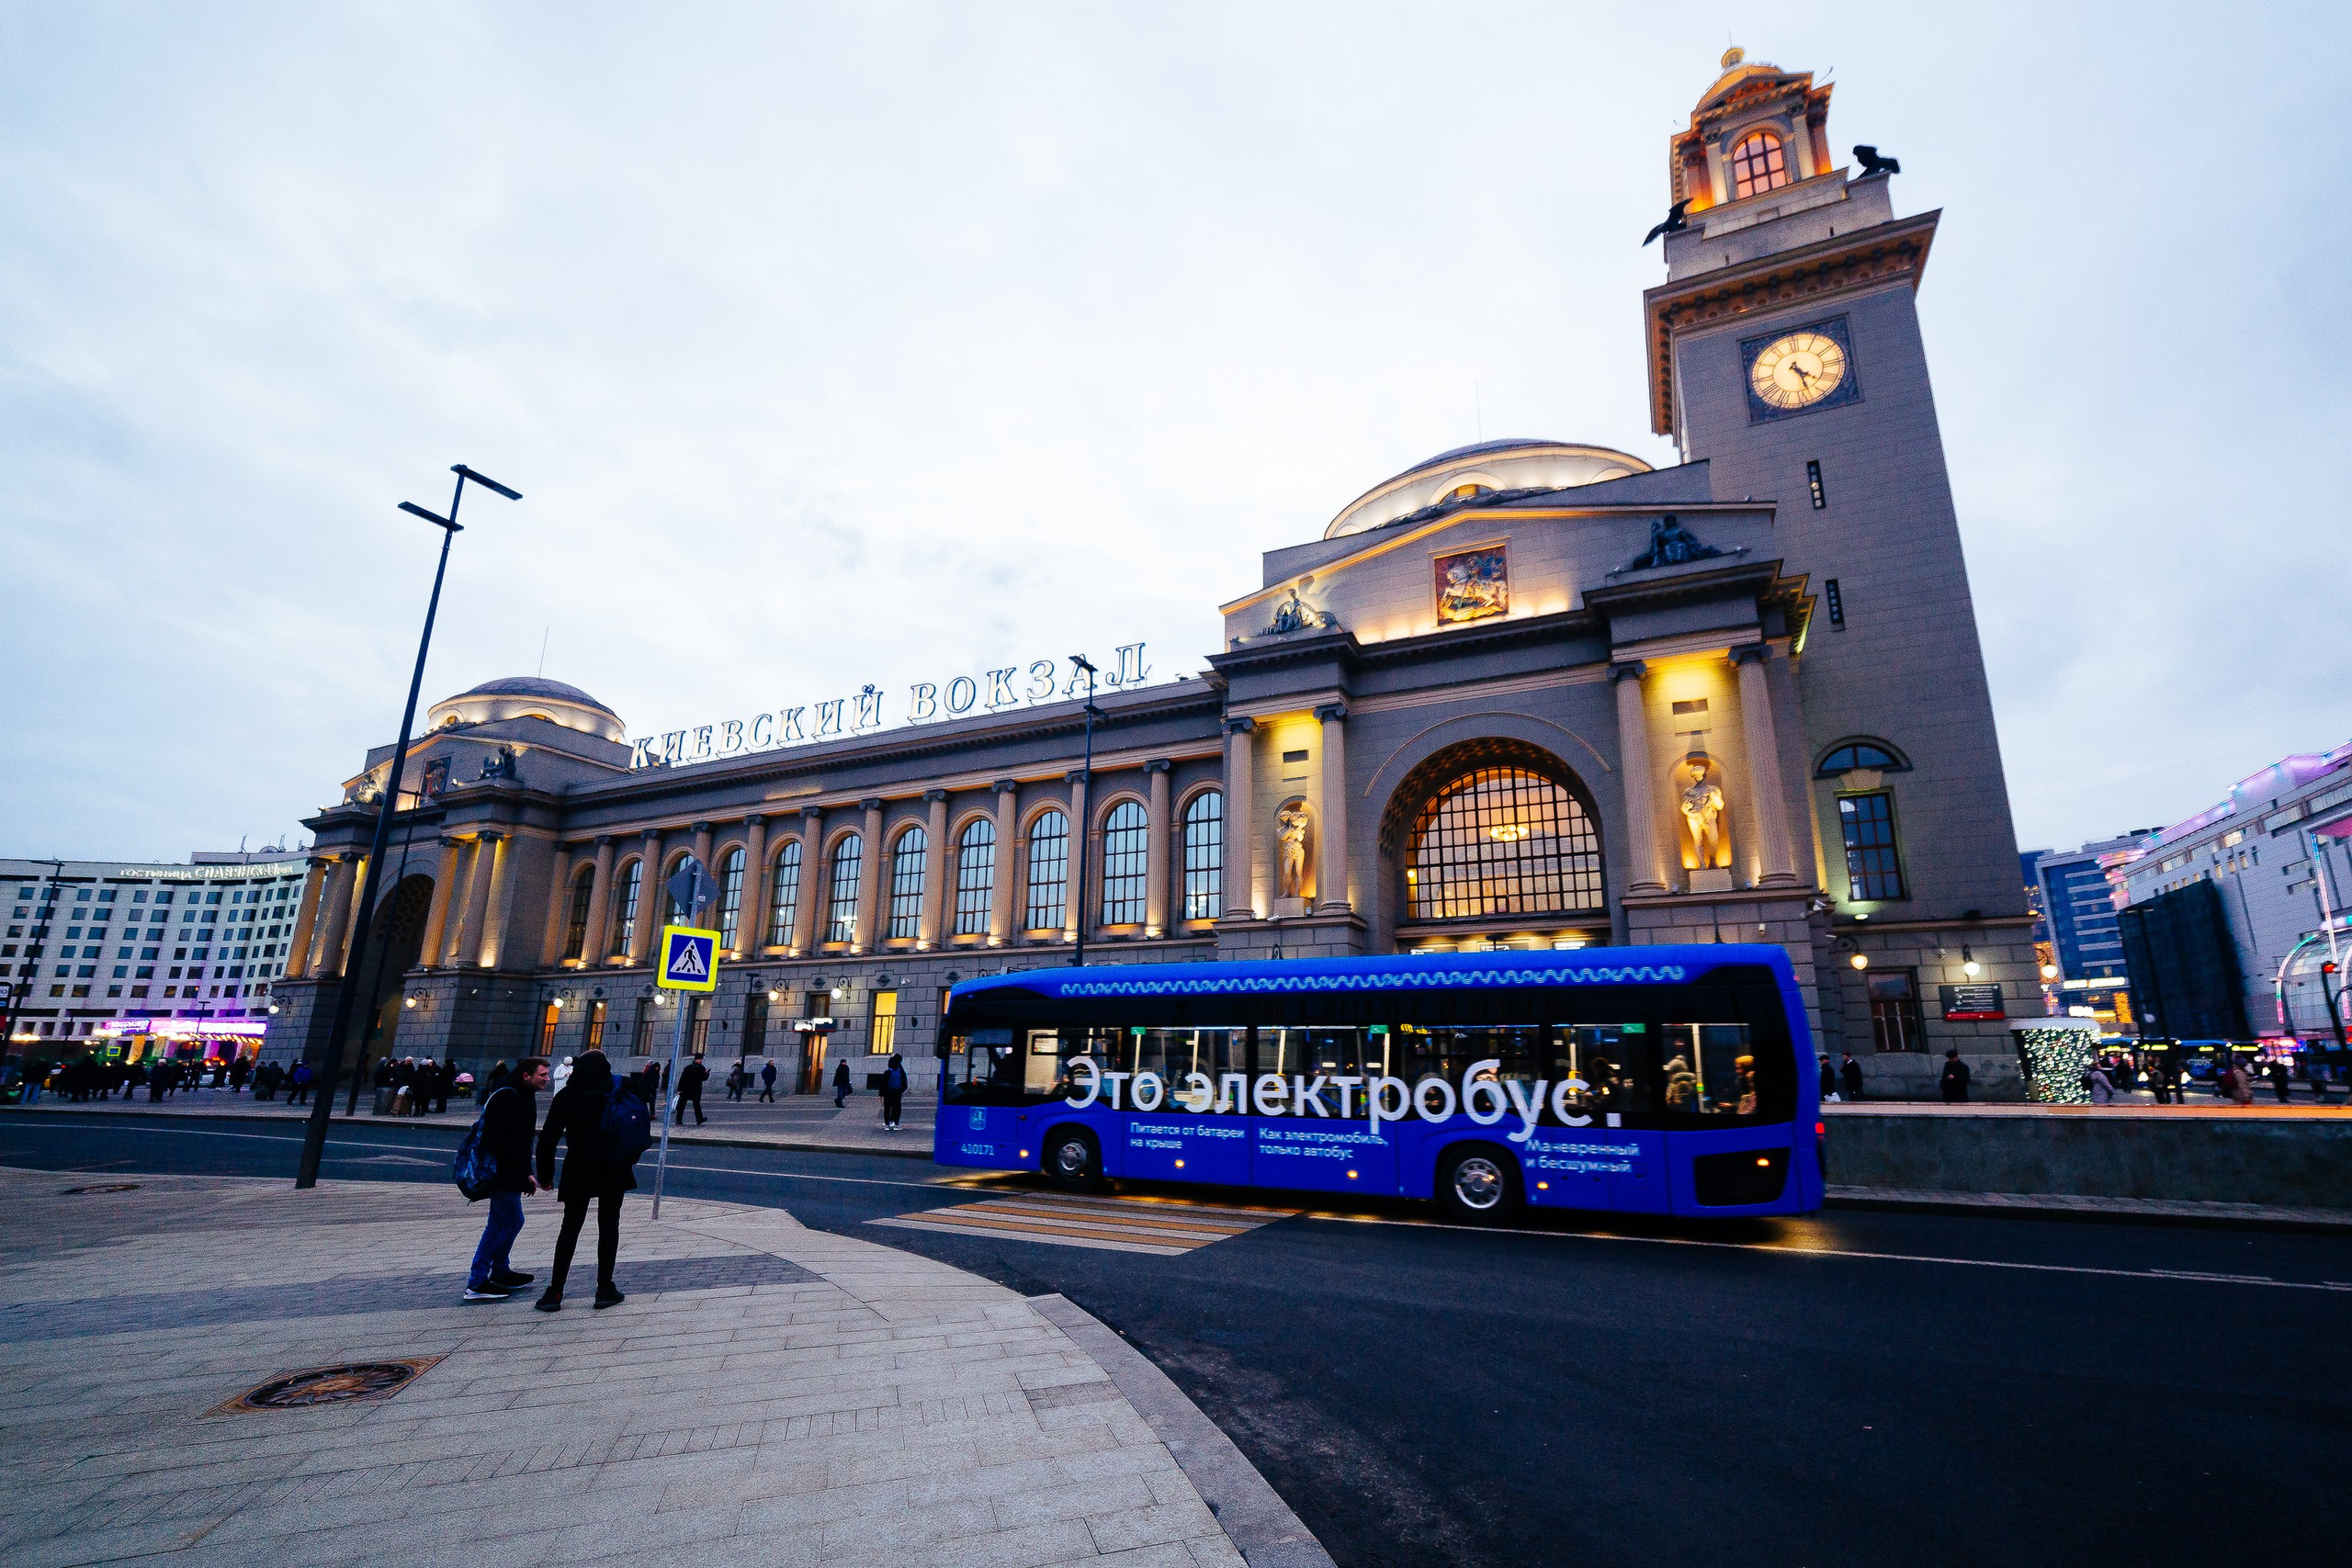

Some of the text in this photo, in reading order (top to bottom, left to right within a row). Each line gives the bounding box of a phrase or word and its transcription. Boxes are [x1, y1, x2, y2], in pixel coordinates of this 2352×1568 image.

[629, 642, 1147, 770] КИЕВСКИЙ ВОКЗАЛ
[1065, 1055, 1623, 1143] Это электробус.
[1130, 1122, 1245, 1140] Питается от батареи
[1259, 1128, 1388, 1146] Как электромобиль,
[961, 1143, 995, 1156] 410171
[1130, 1138, 1182, 1150] на крыше
[1259, 1145, 1354, 1160] только автобус
[1524, 1139, 1640, 1156] Маневренный
[1525, 1156, 1632, 1173] и бесшумный
